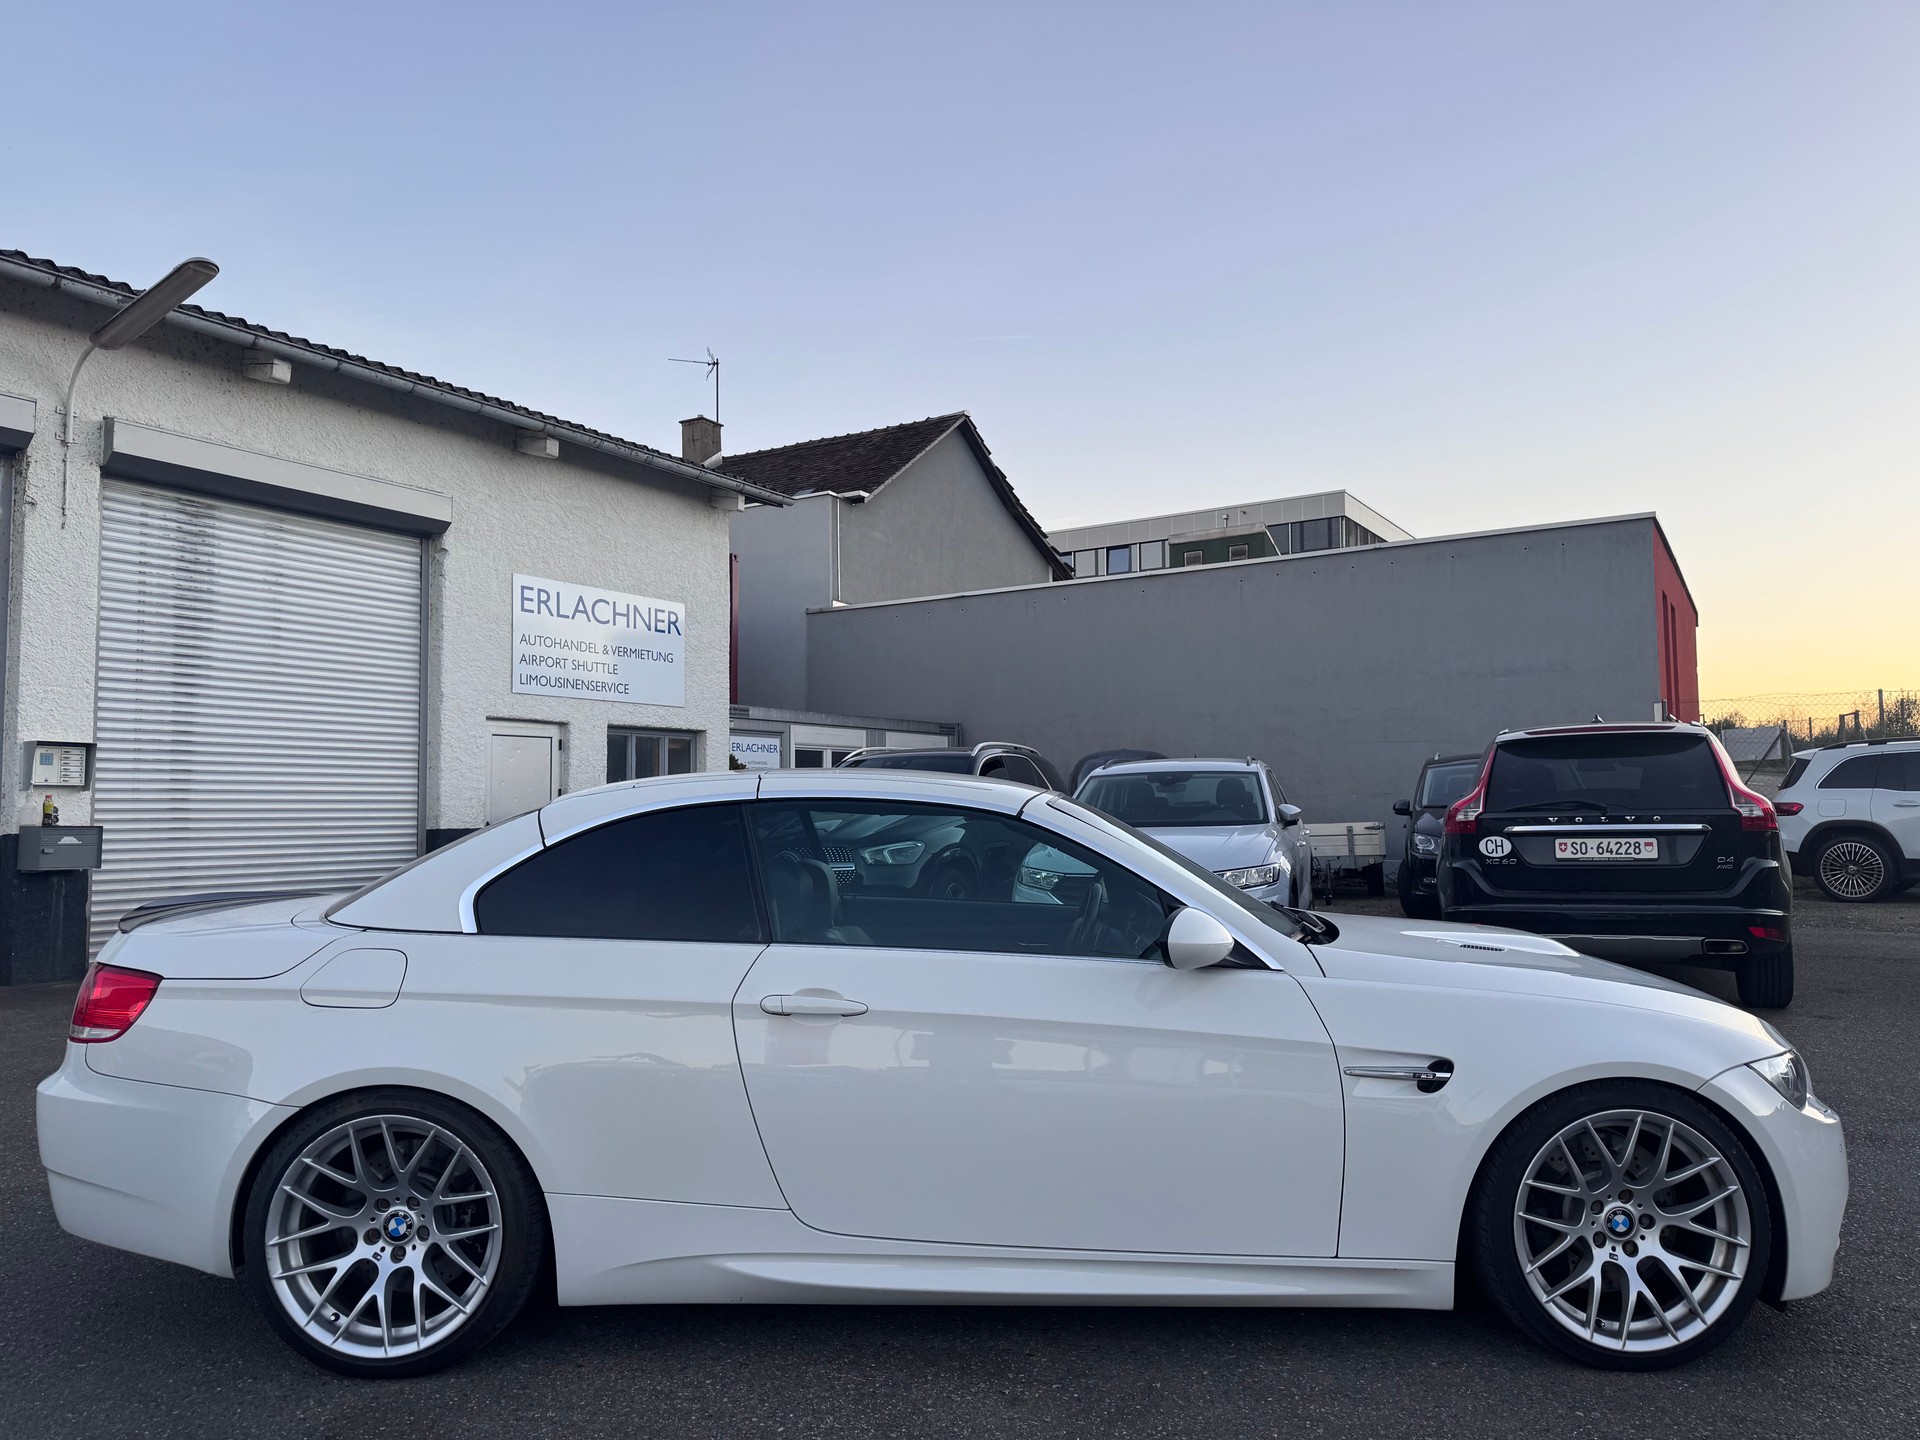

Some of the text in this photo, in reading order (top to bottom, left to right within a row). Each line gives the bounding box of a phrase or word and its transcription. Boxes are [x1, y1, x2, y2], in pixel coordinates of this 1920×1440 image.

[520, 584, 682, 636] ERLACHNER
[519, 633, 600, 655] AUTOHANDEL
[610, 645, 674, 664] VERMIETUNG
[519, 653, 619, 675] AIRPORT SHUTTLE
[519, 673, 630, 695] LIMOUSINENSERVICE
[731, 742, 779, 753] ERLACHNER
[1547, 815, 1661, 824] VOLVO
[1485, 838, 1505, 855] CH
